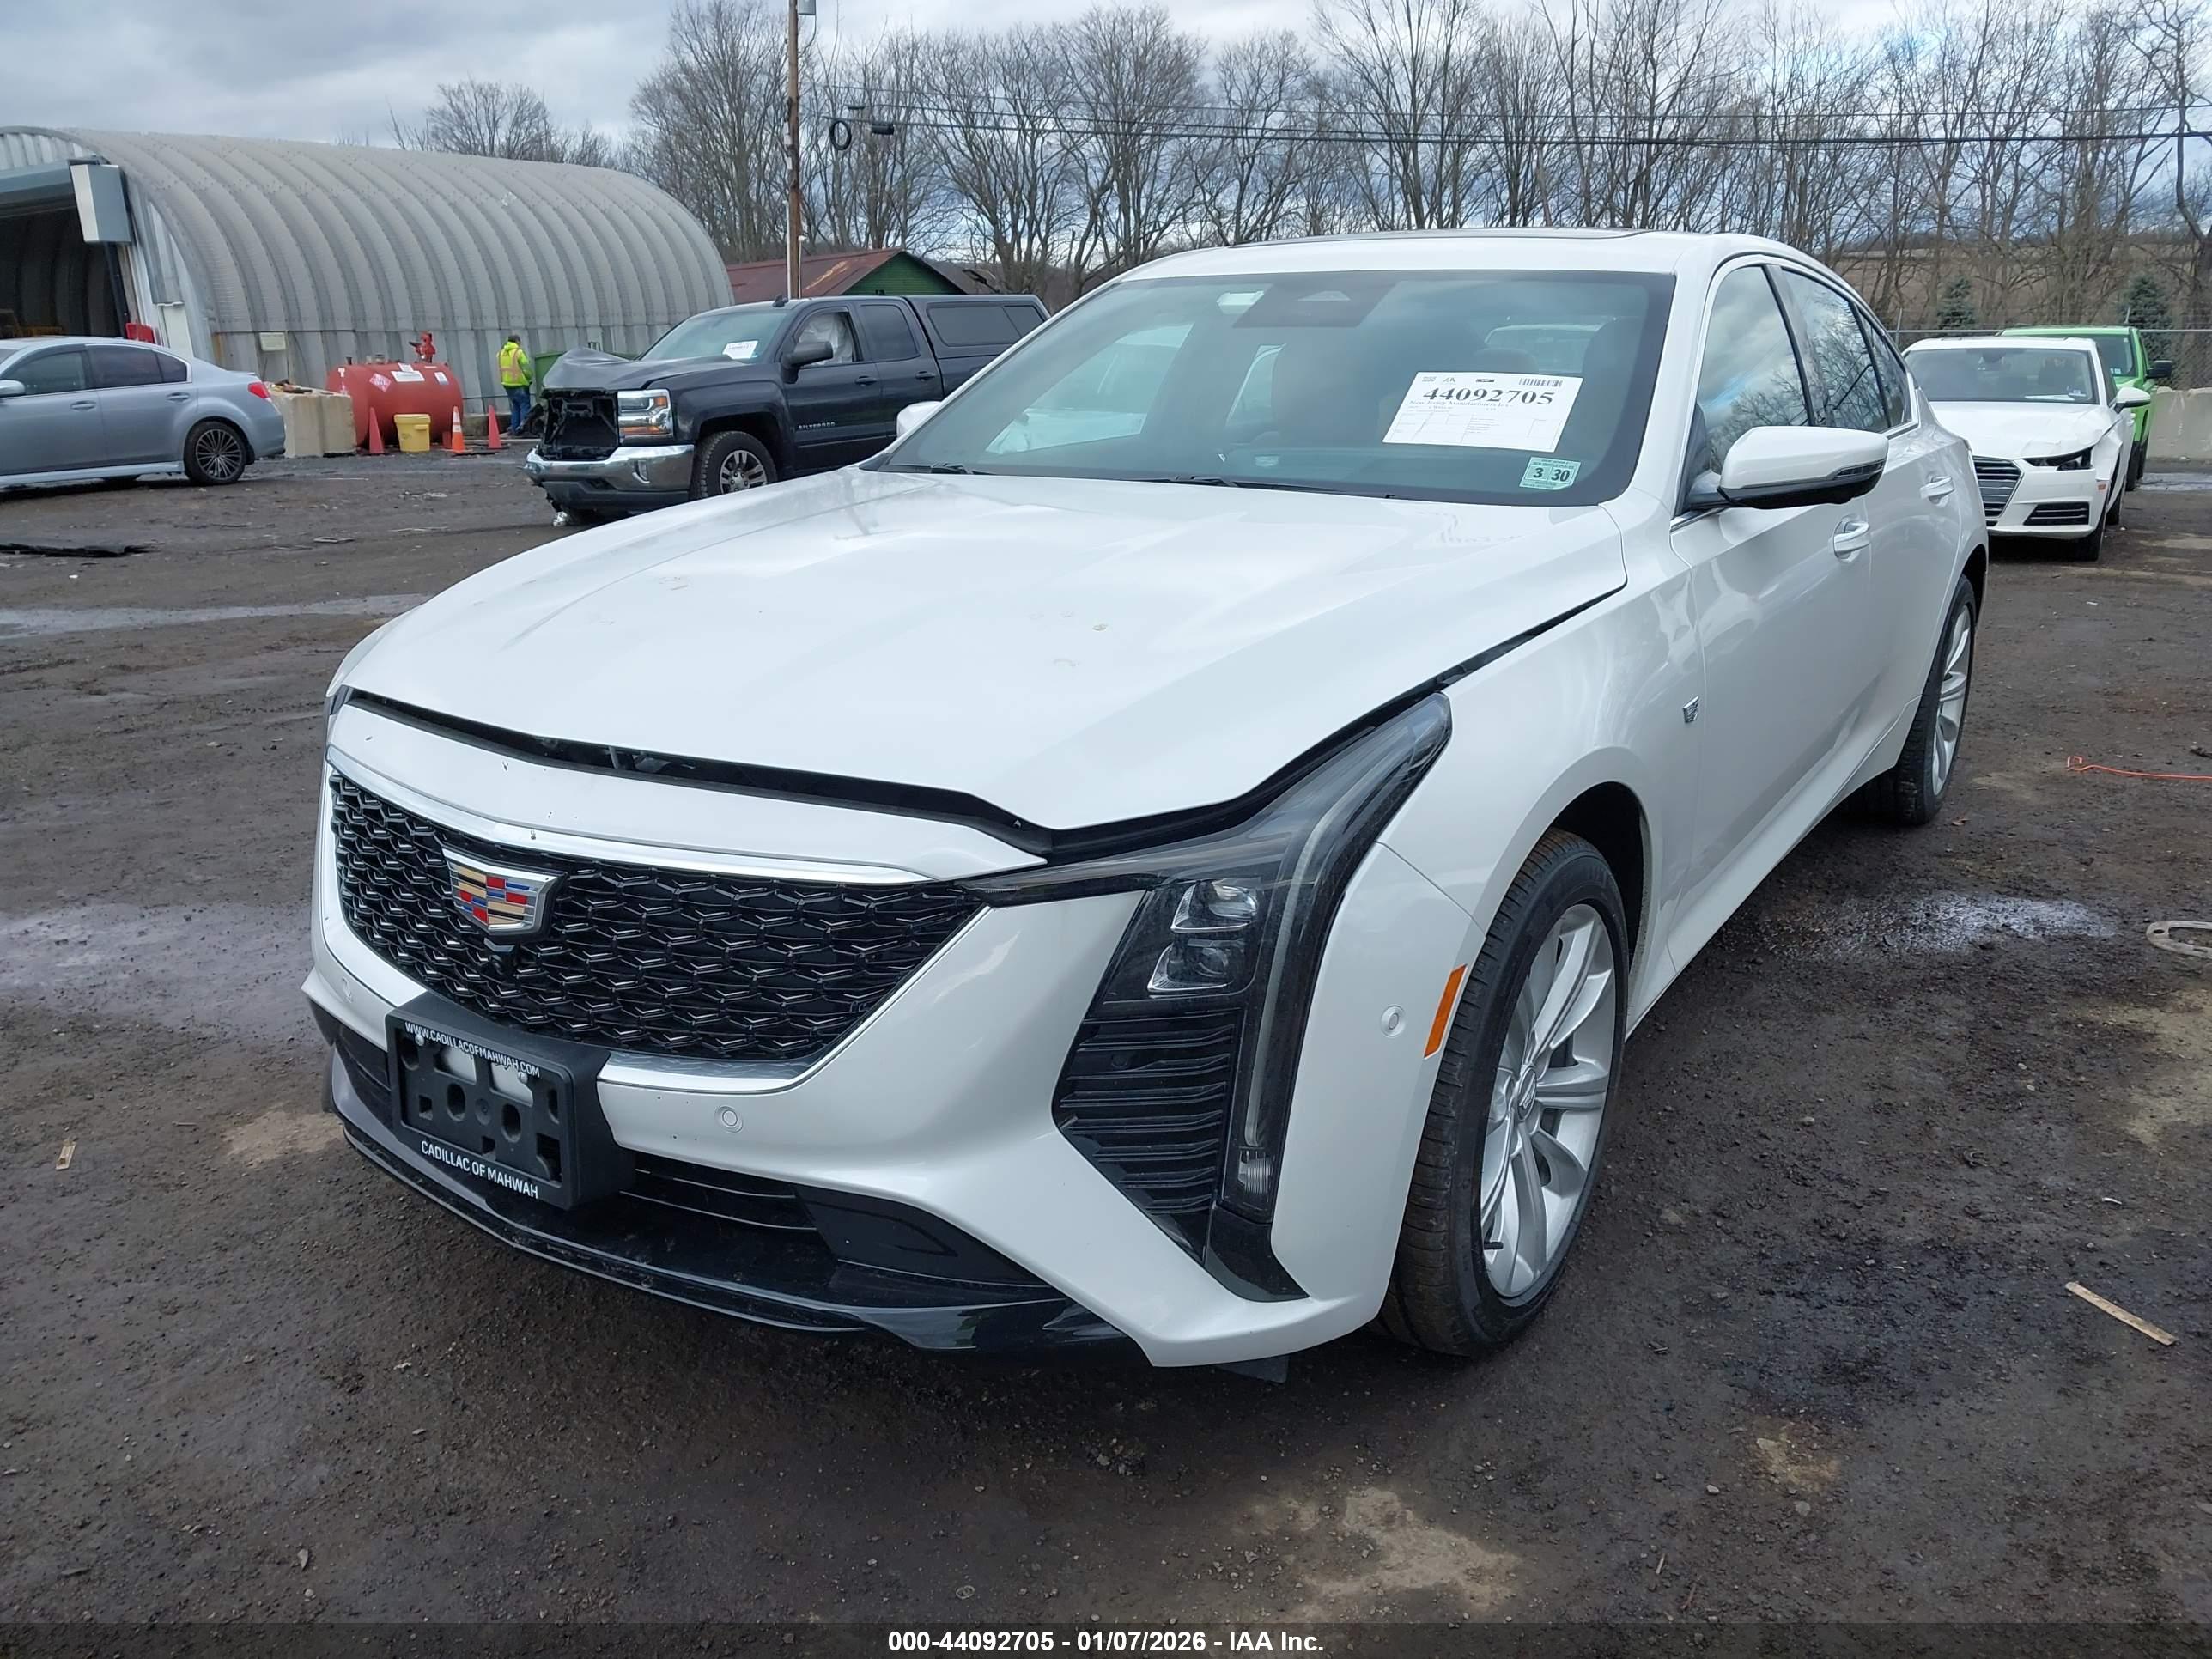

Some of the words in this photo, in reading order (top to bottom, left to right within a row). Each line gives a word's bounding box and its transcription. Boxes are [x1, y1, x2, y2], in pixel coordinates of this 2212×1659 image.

[1423, 387, 1555, 404] 44092705
[1533, 467, 1544, 478] 3
[1551, 469, 1570, 482] 30
[404, 1021, 540, 1078] WWW.CADILLACOFMAHWAH.COM
[421, 1140, 470, 1172] CADILLAC
[471, 1161, 486, 1177] OF
[487, 1167, 538, 1200] MAHWAH
